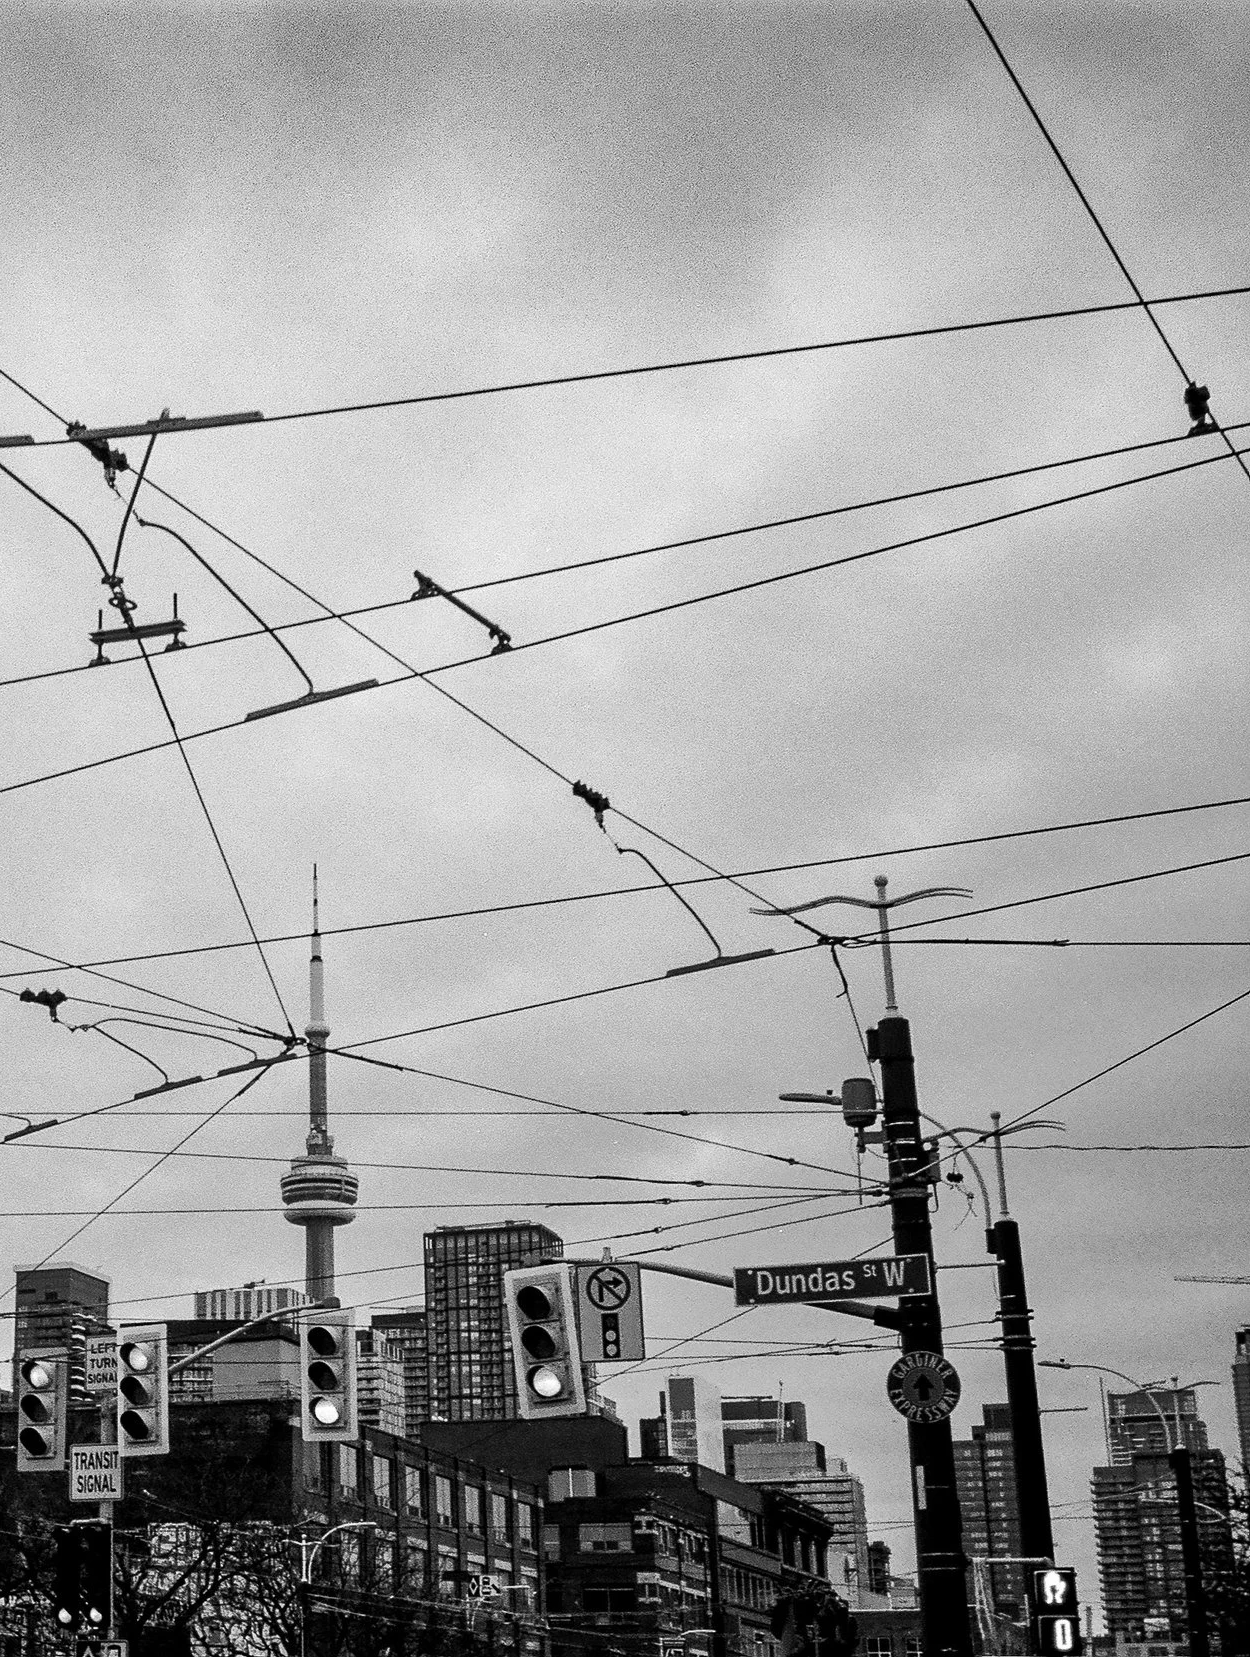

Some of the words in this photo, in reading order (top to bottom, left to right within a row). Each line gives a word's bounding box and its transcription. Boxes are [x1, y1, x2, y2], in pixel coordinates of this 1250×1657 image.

[757, 1267, 856, 1296] Dundas
[863, 1264, 877, 1278] St
[882, 1260, 905, 1287] W
[892, 1354, 953, 1379] GARDINER
[890, 1388, 958, 1421] EXPRESSWAY
[73, 1451, 119, 1470] TRANSIT
[76, 1474, 117, 1493] SIGNAL
[1054, 1619, 1072, 1650] 0
